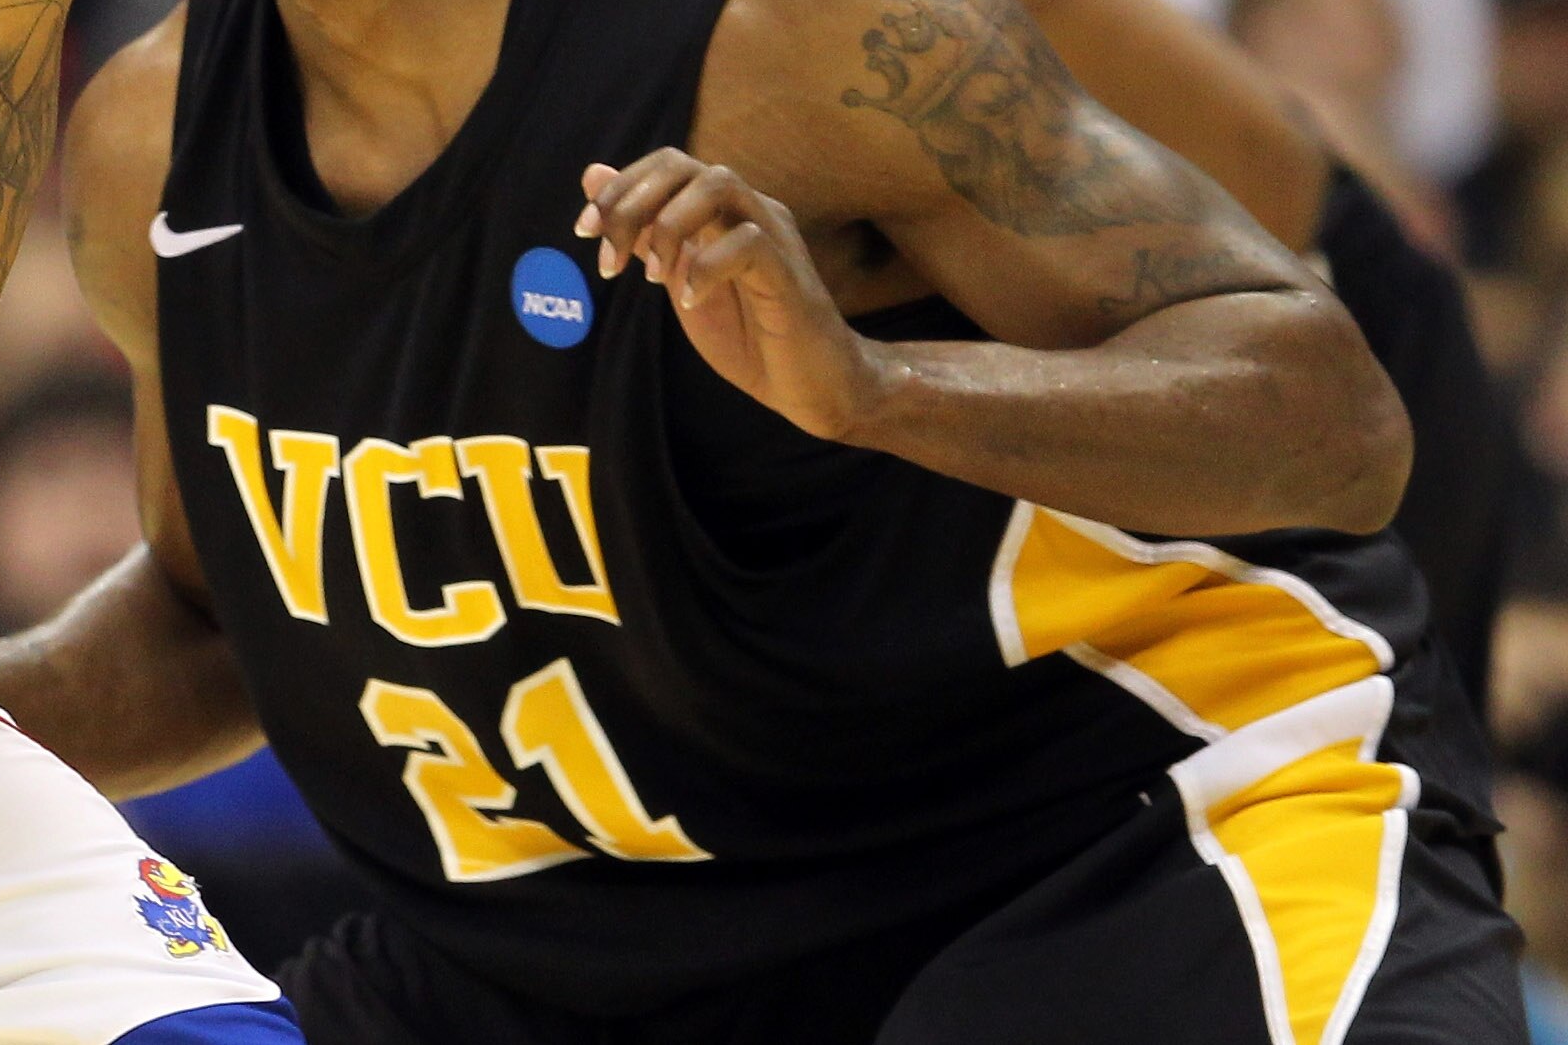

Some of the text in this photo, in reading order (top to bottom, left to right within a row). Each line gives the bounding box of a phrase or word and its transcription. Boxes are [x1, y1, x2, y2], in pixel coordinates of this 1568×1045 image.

[521, 290, 584, 323] NCAA
[206, 403, 622, 648] VCU
[358, 656, 715, 883] 21
